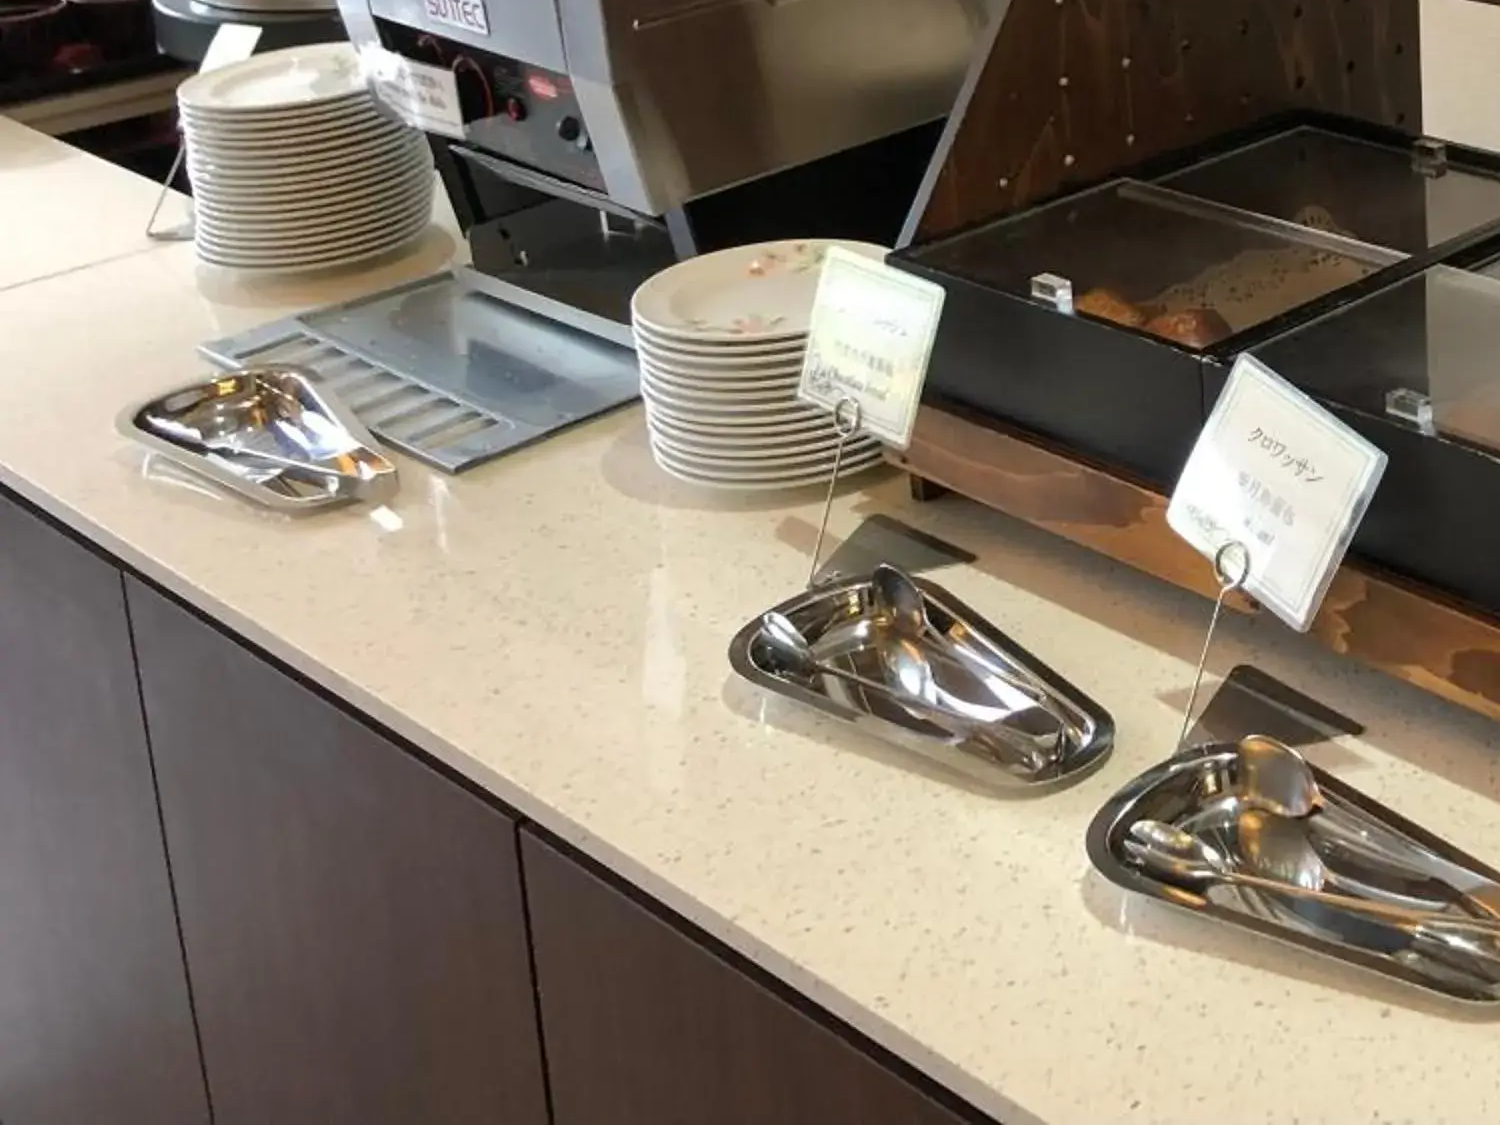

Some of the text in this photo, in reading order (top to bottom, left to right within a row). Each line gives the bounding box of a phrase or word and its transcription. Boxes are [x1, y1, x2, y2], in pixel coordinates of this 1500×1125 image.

[1247, 427, 1324, 482] クロワッサン
